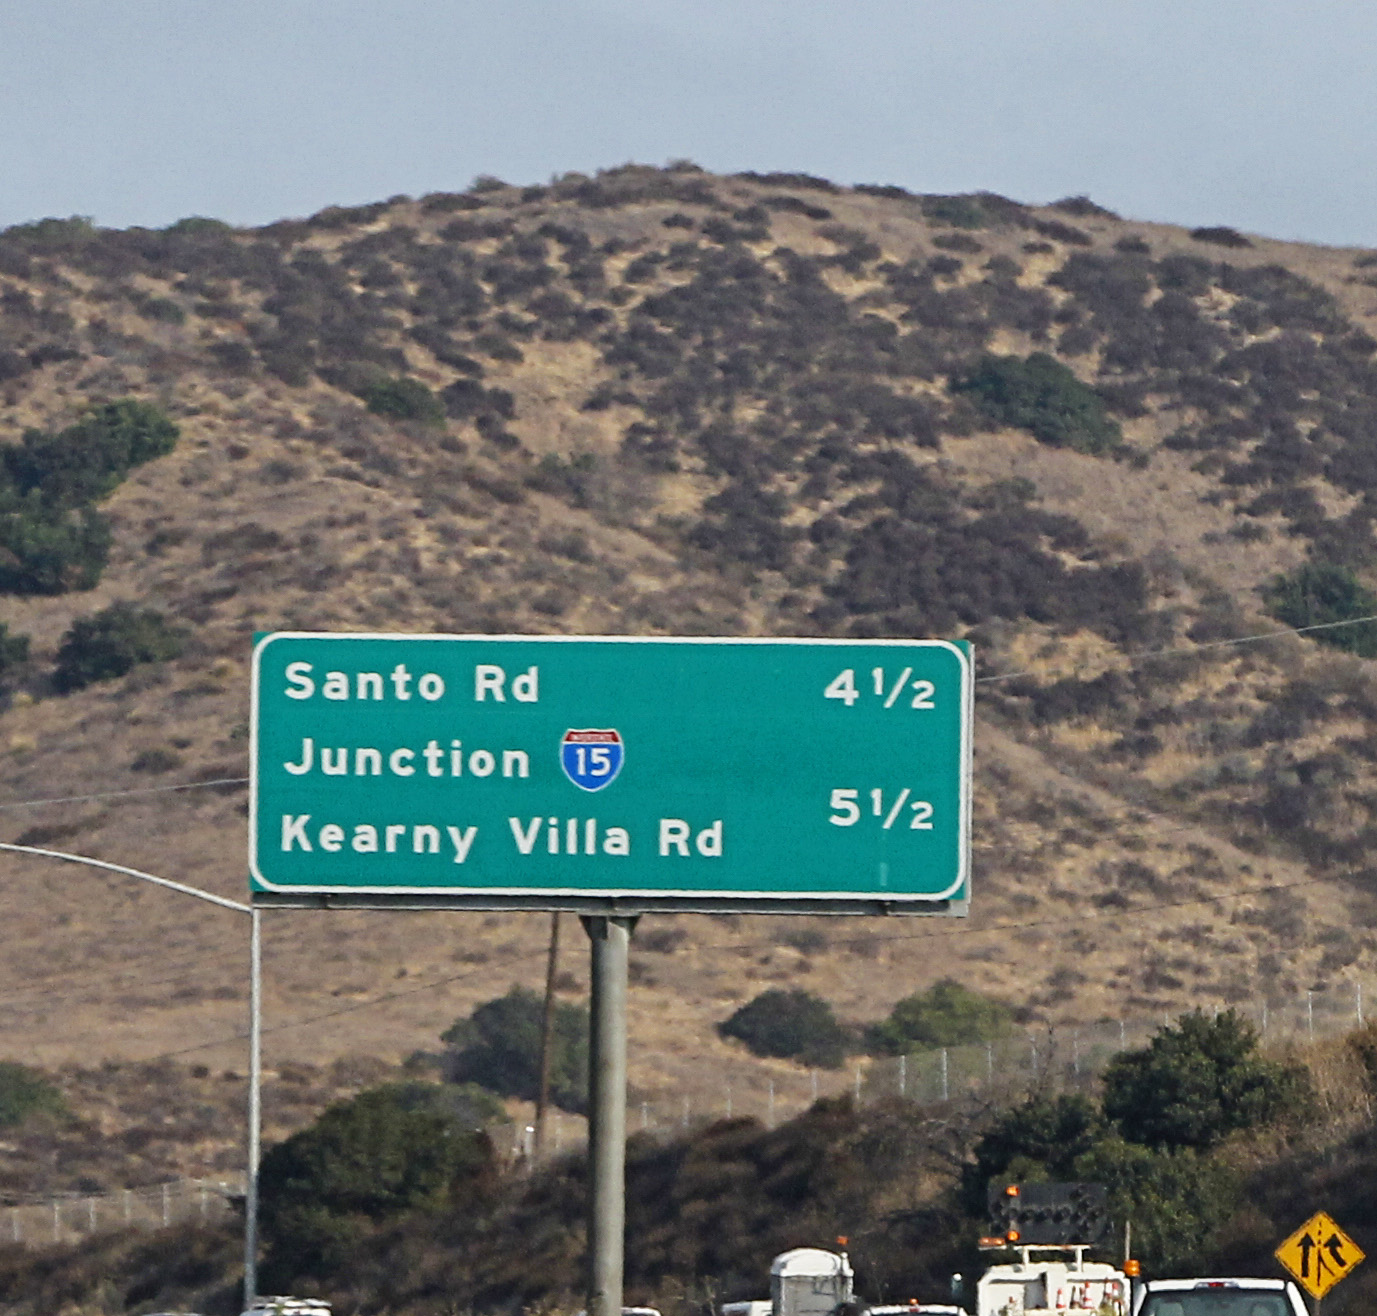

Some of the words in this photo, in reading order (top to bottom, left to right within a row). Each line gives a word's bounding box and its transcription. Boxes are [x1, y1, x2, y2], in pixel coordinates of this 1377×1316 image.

[284, 661, 446, 701] Santo
[475, 664, 539, 703] Rd
[283, 737, 530, 778] Junction
[576, 747, 611, 776] 15
[280, 813, 479, 864] Kearny
[508, 816, 630, 856] Villa
[658, 818, 723, 857] Rd
